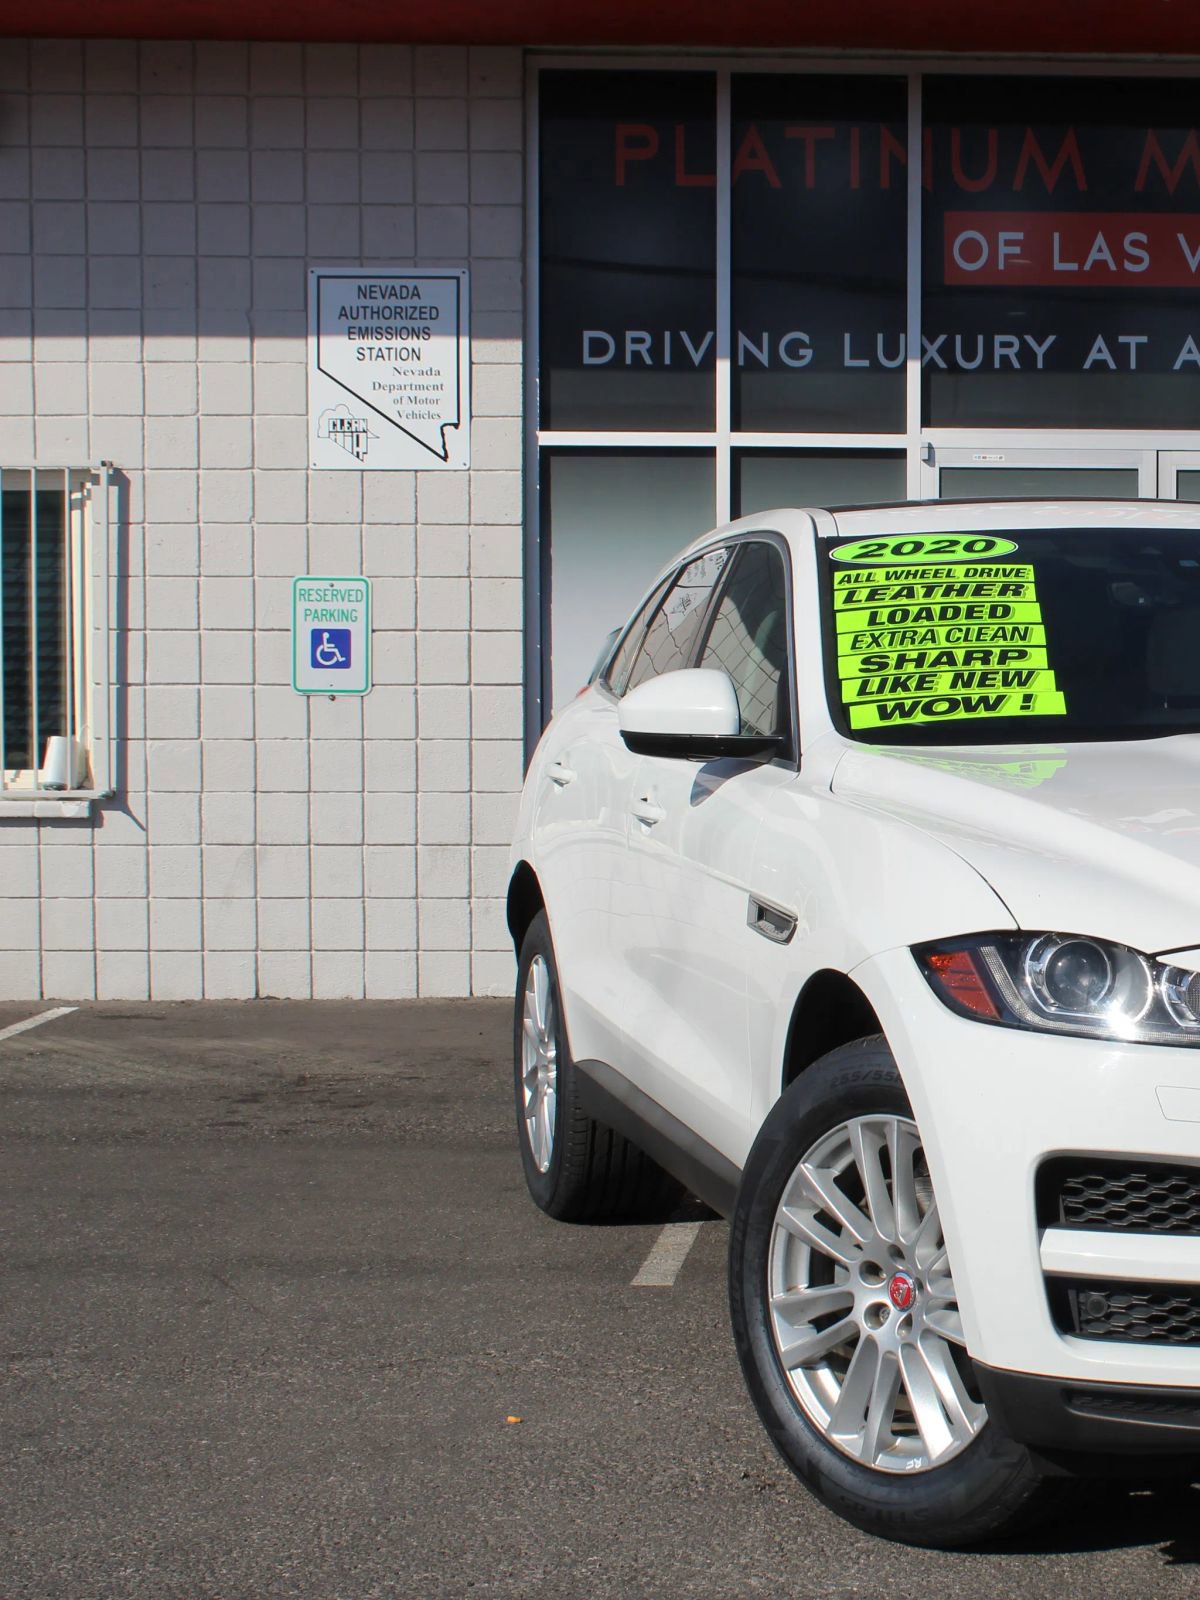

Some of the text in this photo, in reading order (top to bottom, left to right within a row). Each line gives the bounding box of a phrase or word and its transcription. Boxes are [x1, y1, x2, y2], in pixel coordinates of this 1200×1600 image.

[614, 123, 1088, 193] PLATINUM
[952, 230, 1024, 272] OF
[1053, 231, 1151, 272] LAS
[357, 285, 421, 300] NEVADA
[338, 305, 439, 320] AUTHORIZED
[347, 326, 431, 341] EMISSIONS
[356, 347, 421, 361] STATION
[582, 330, 814, 369] DRIVNG
[844, 333, 1057, 370] LUXURY
[1083, 335, 1148, 369] AT
[392, 367, 441, 376] Nevada
[372, 381, 444, 393] Department
[393, 396, 441, 405] of Motor
[397, 410, 441, 420] Vehicles
[851, 538, 997, 560] 2020
[838, 567, 1028, 585] ALL WHEEL DRIVE
[298, 588, 364, 602] RESERVED
[842, 583, 1026, 605] LEATHER
[304, 608, 358, 622] PARKING
[867, 604, 1013, 627] LOADED
[851, 626, 1030, 651] EXTRA CLEAN
[858, 649, 1030, 674] SHARP
[856, 671, 1036, 697] LIKE NEW
[876, 694, 1007, 721] WOW
[830, 1070, 900, 1089] 255/55
